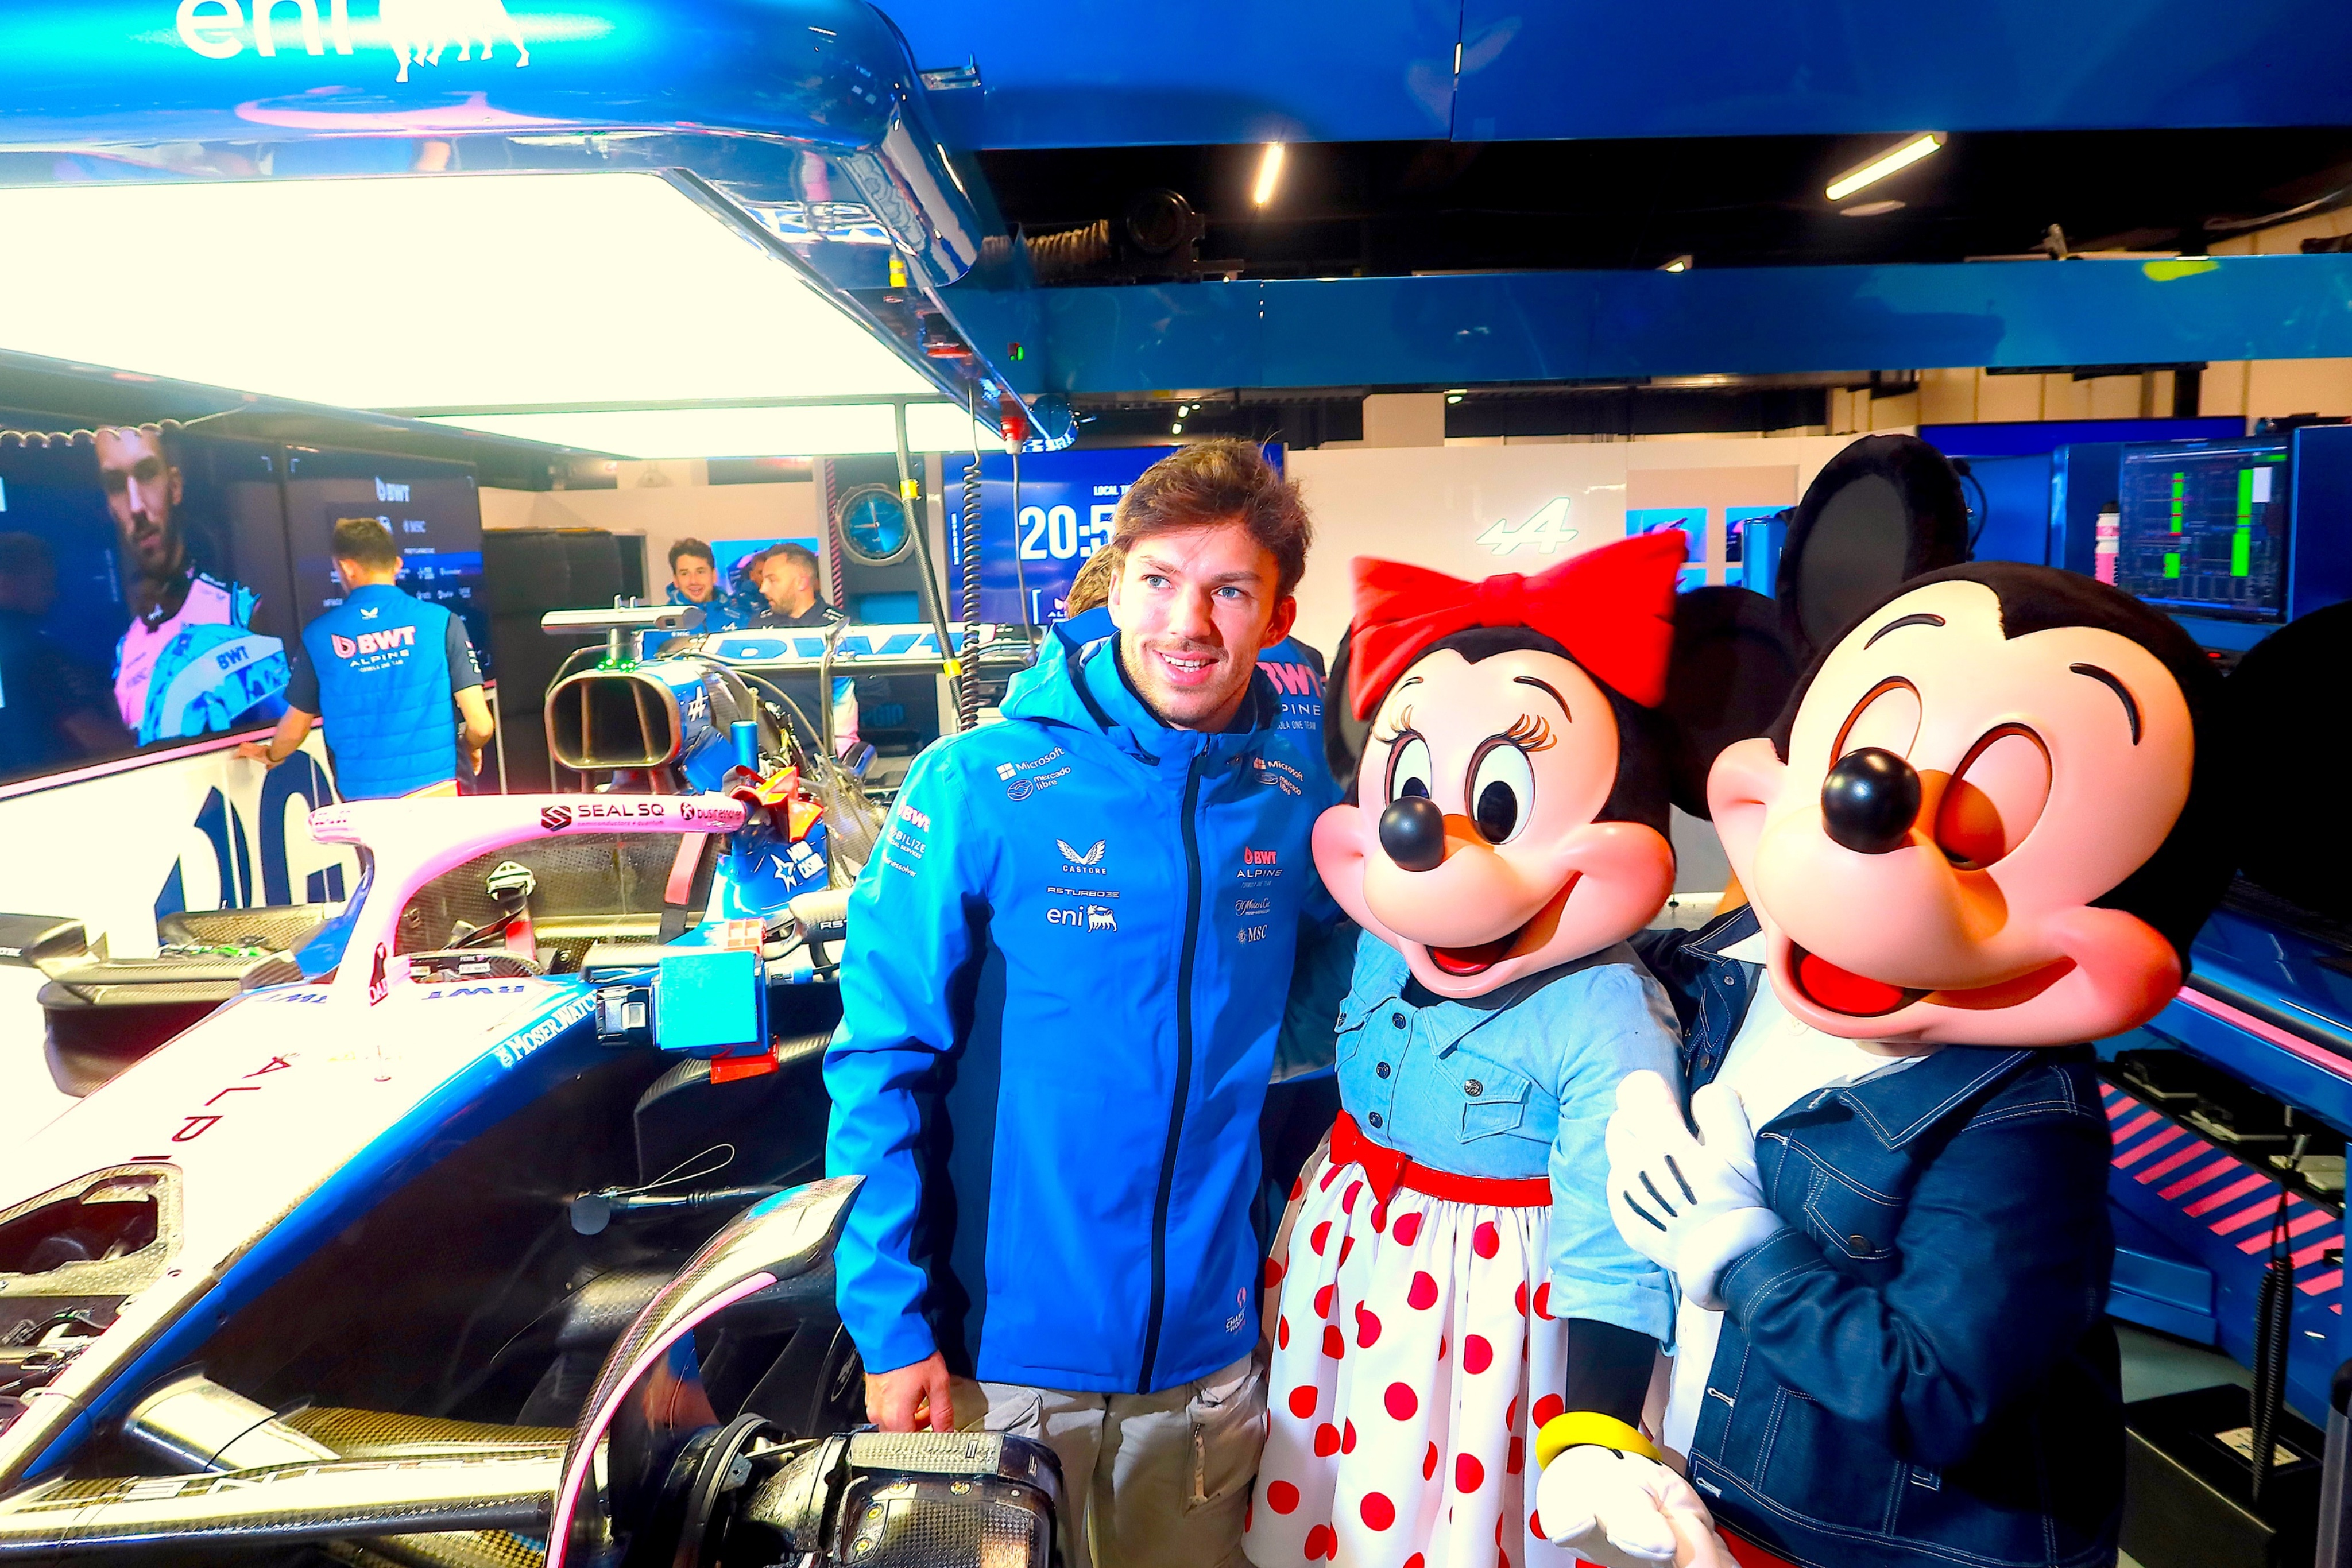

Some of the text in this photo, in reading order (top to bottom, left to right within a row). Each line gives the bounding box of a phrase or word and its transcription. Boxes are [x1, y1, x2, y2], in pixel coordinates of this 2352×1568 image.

[176, 0, 354, 59] eni
[1094, 485, 1119, 496] LOCAL
[1018, 504, 1117, 560] 20:5
[357, 625, 416, 655] BWT
[216, 646, 249, 670] BWT
[349, 649, 410, 667] ALPINE
[1282, 703, 1321, 715] PINE
[1015, 747, 1065, 771] Microsoft
[1034, 766, 1071, 782] mercado
[1267, 760, 1303, 782] Microsoft
[1036, 779, 1058, 791] libre
[1280, 776, 1301, 796] mercado
[902, 804, 930, 833] BWT
[1254, 850, 1276, 864] BWT
[1063, 865, 1107, 874] CASTORE
[1237, 869, 1283, 877] ALPINE
[1046, 905, 1084, 926] eni
[1248, 924, 1268, 943] MSC
